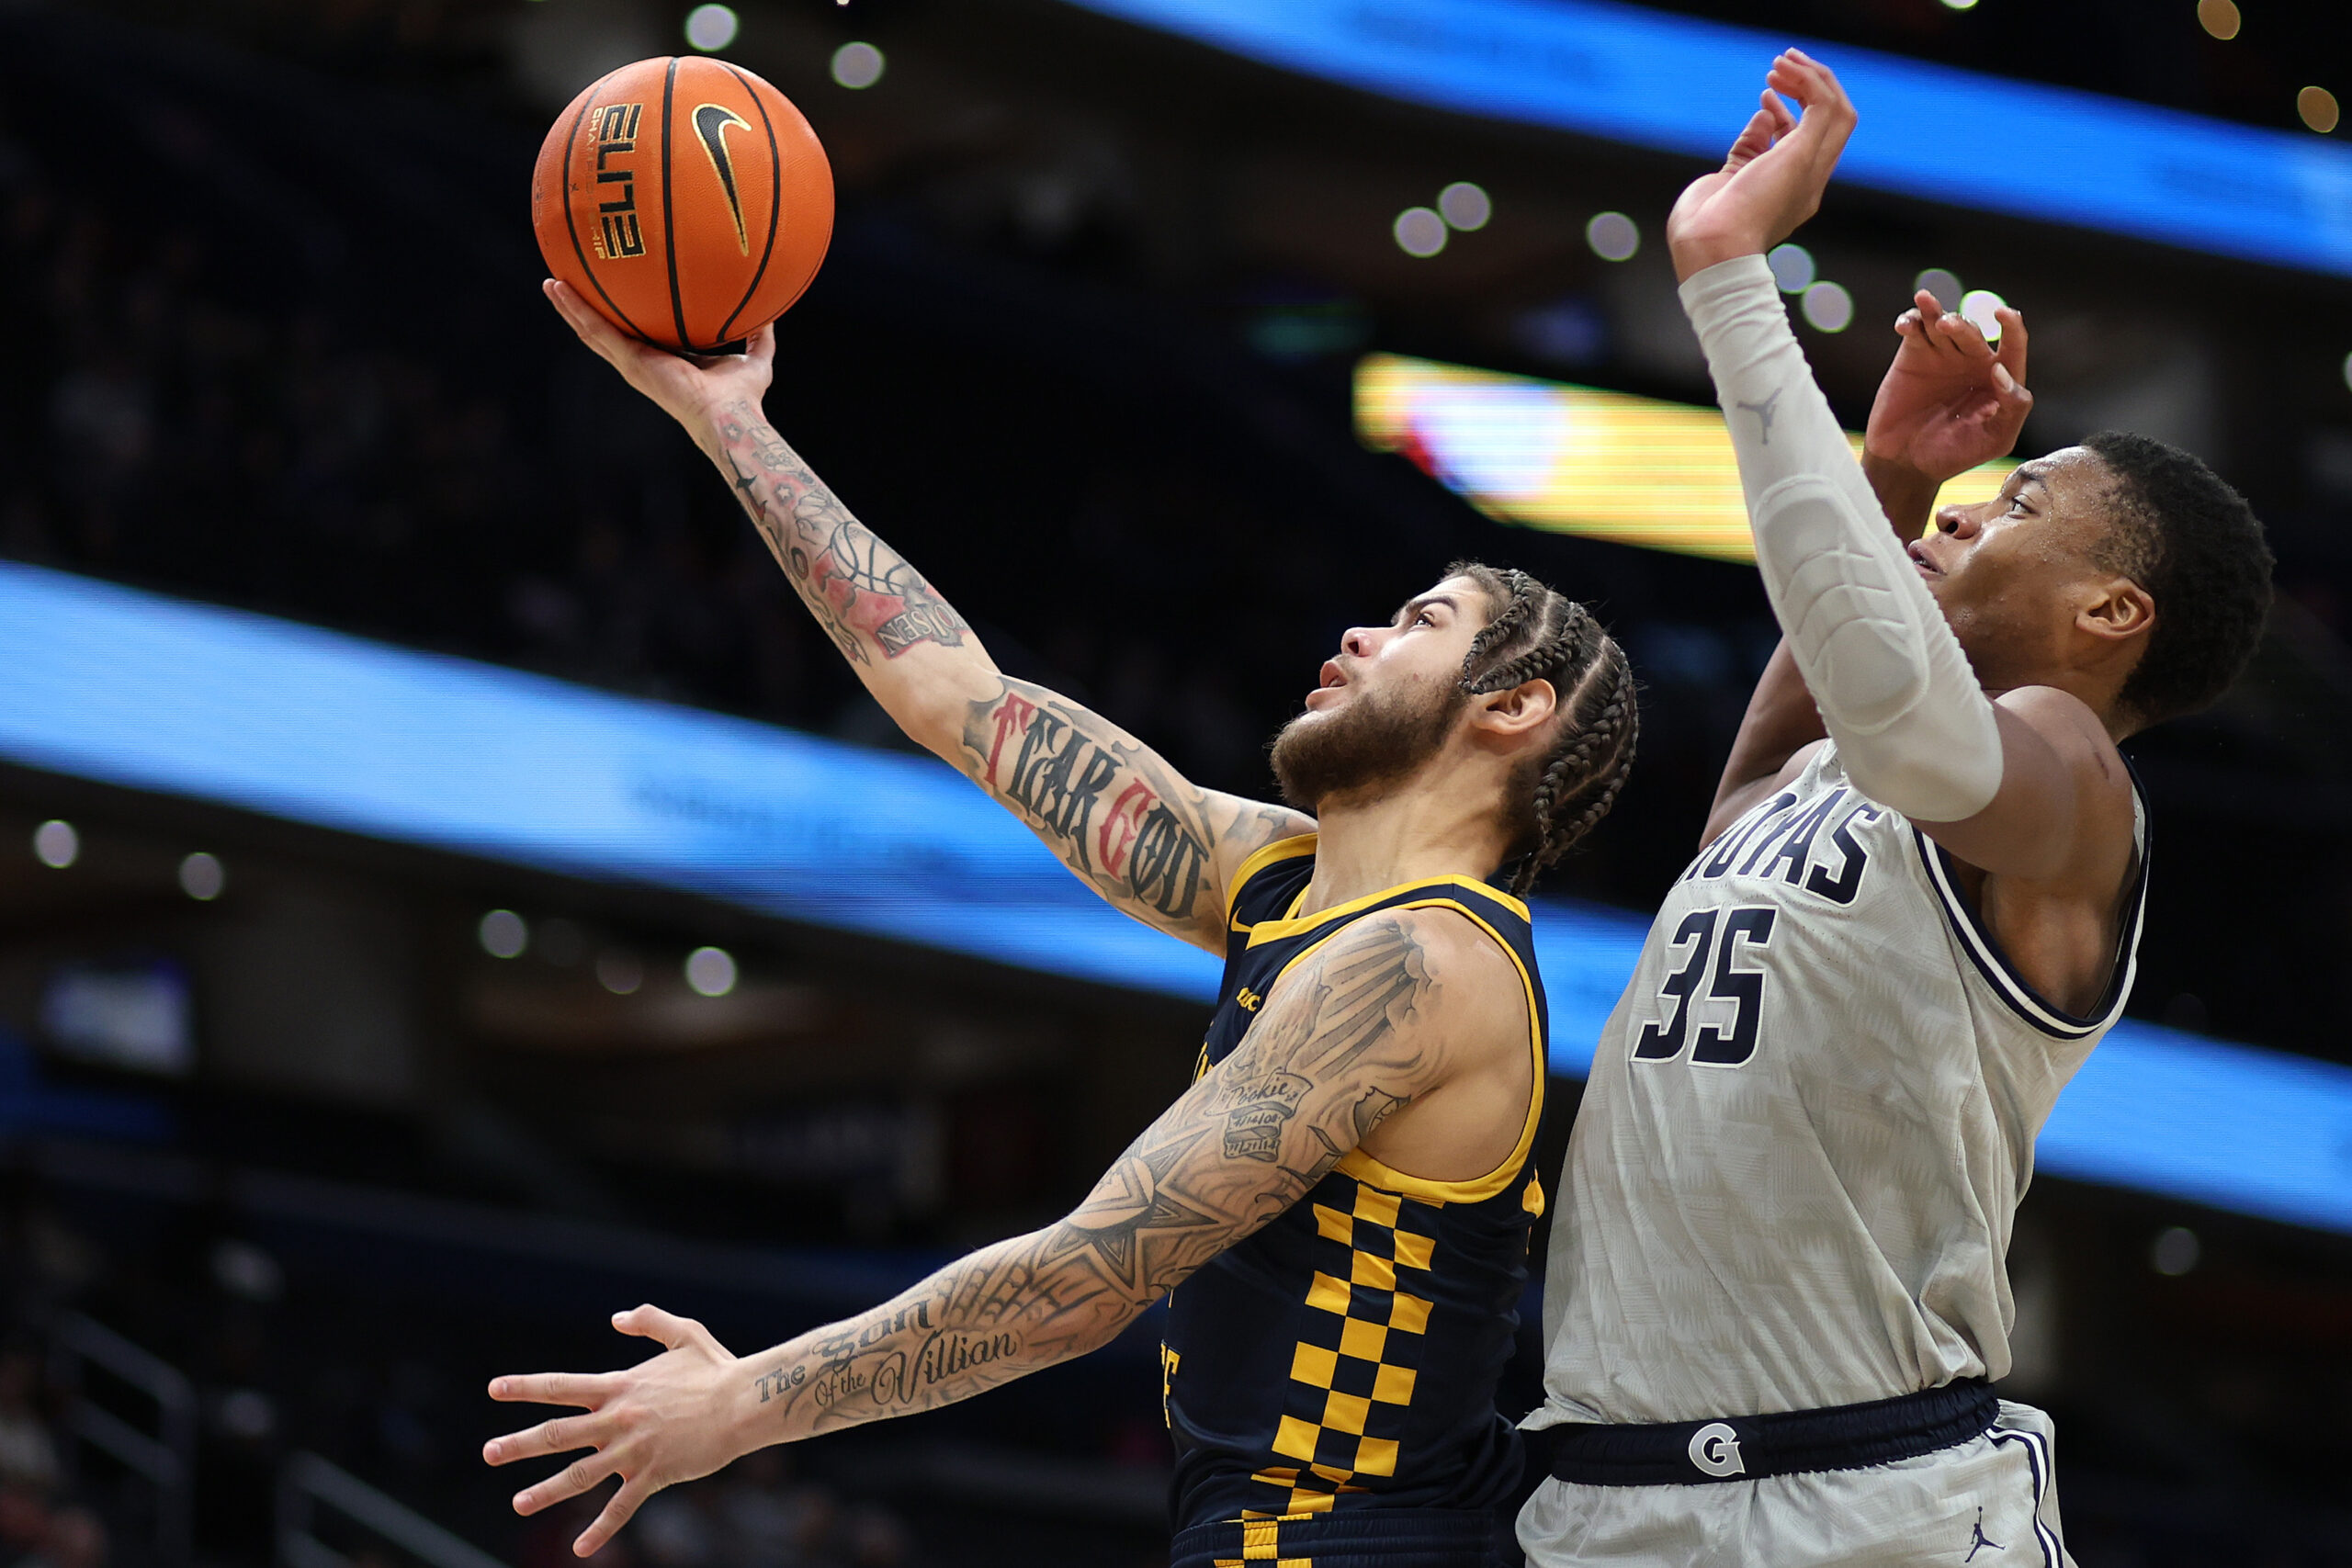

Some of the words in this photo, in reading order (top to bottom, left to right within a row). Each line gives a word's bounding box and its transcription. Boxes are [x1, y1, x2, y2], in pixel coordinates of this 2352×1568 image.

[597, 103, 646, 259] ELITE
[983, 692, 1124, 878] FEAR
[1098, 776, 1210, 919] GOD
[1629, 905, 1780, 1069] 35
[754, 1362, 806, 1403] The
[840, 1366, 866, 1394] the
[871, 1328, 1017, 1405] Villian
[1689, 1422, 1746, 1477] G
